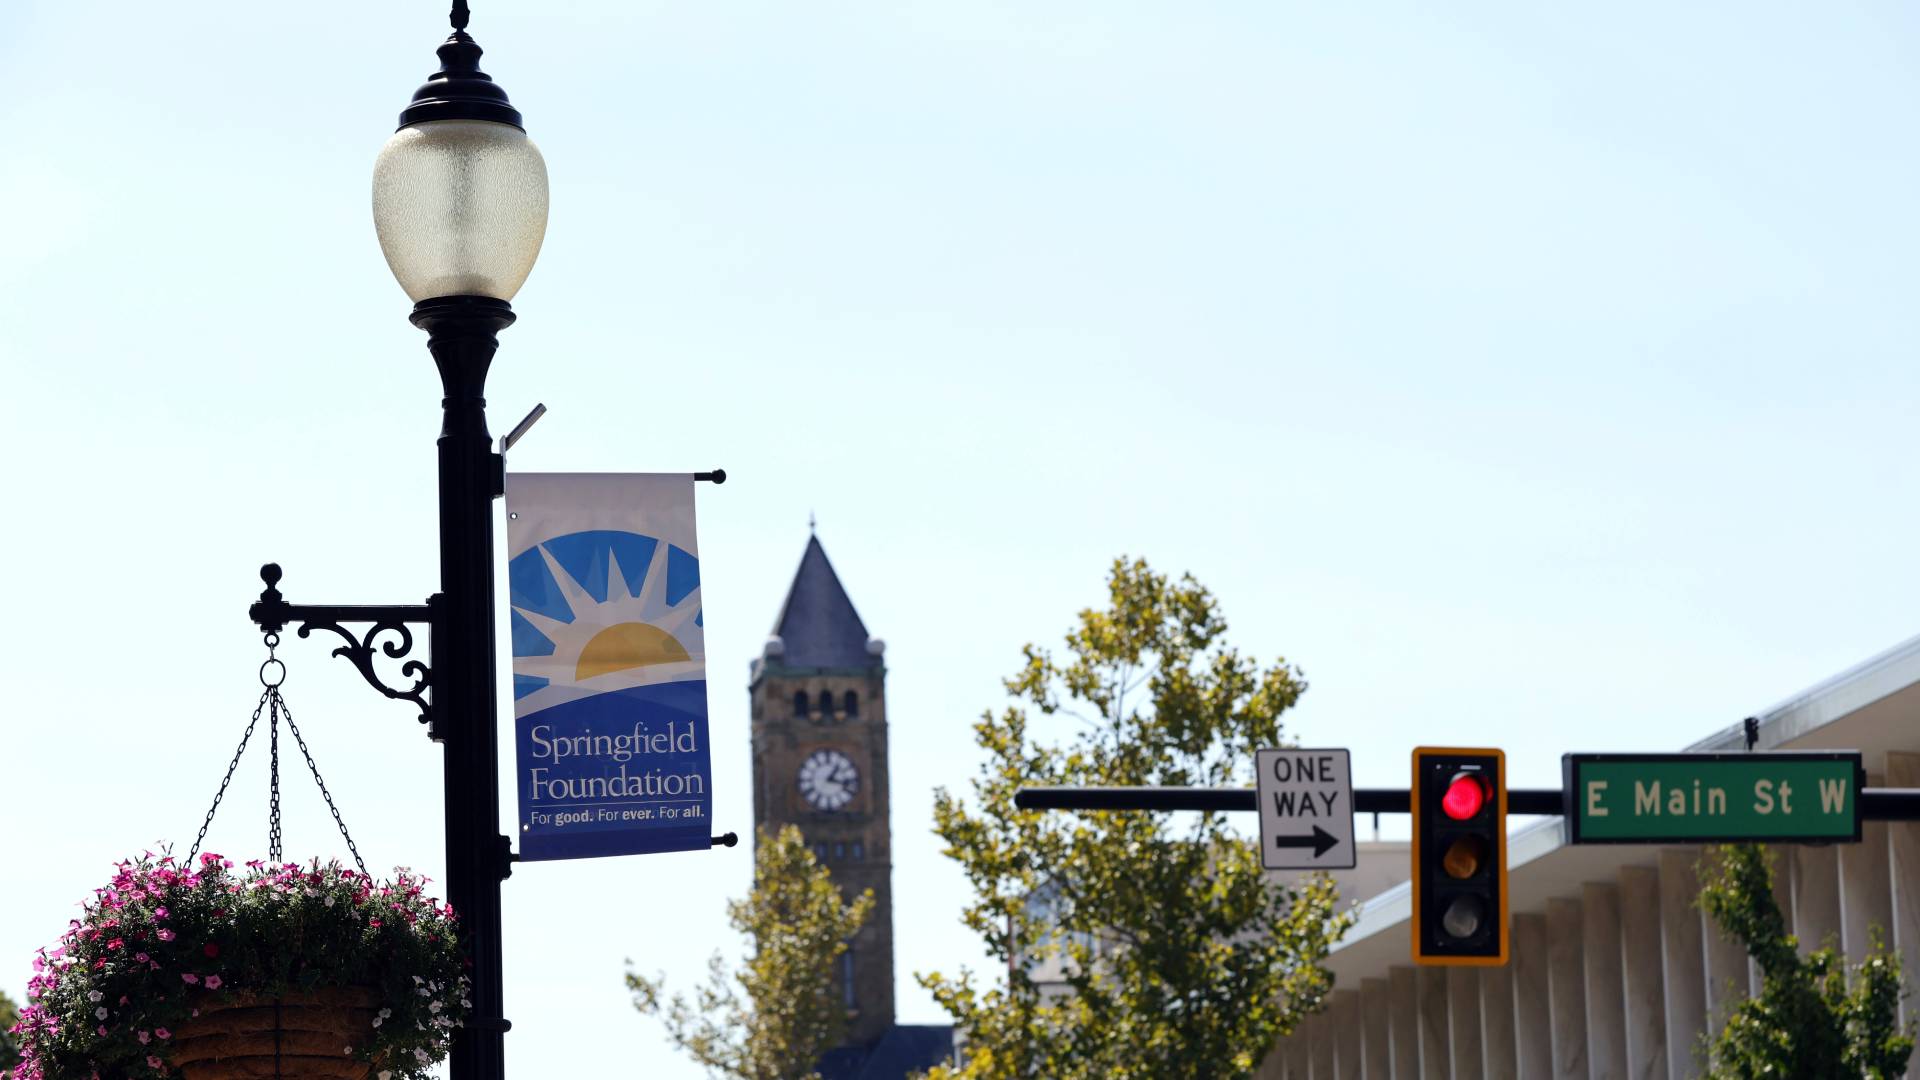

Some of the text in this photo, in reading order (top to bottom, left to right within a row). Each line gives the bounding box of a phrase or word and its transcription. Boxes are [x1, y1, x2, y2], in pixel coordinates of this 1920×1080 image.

[531, 721, 698, 765] Springfield
[530, 764, 704, 800] Foundation
[1274, 756, 1336, 783] ONE
[1273, 790, 1339, 818] WAY
[1587, 778, 1847, 816] E Main St W
[531, 805, 705, 827] For good. For ever. For all.
